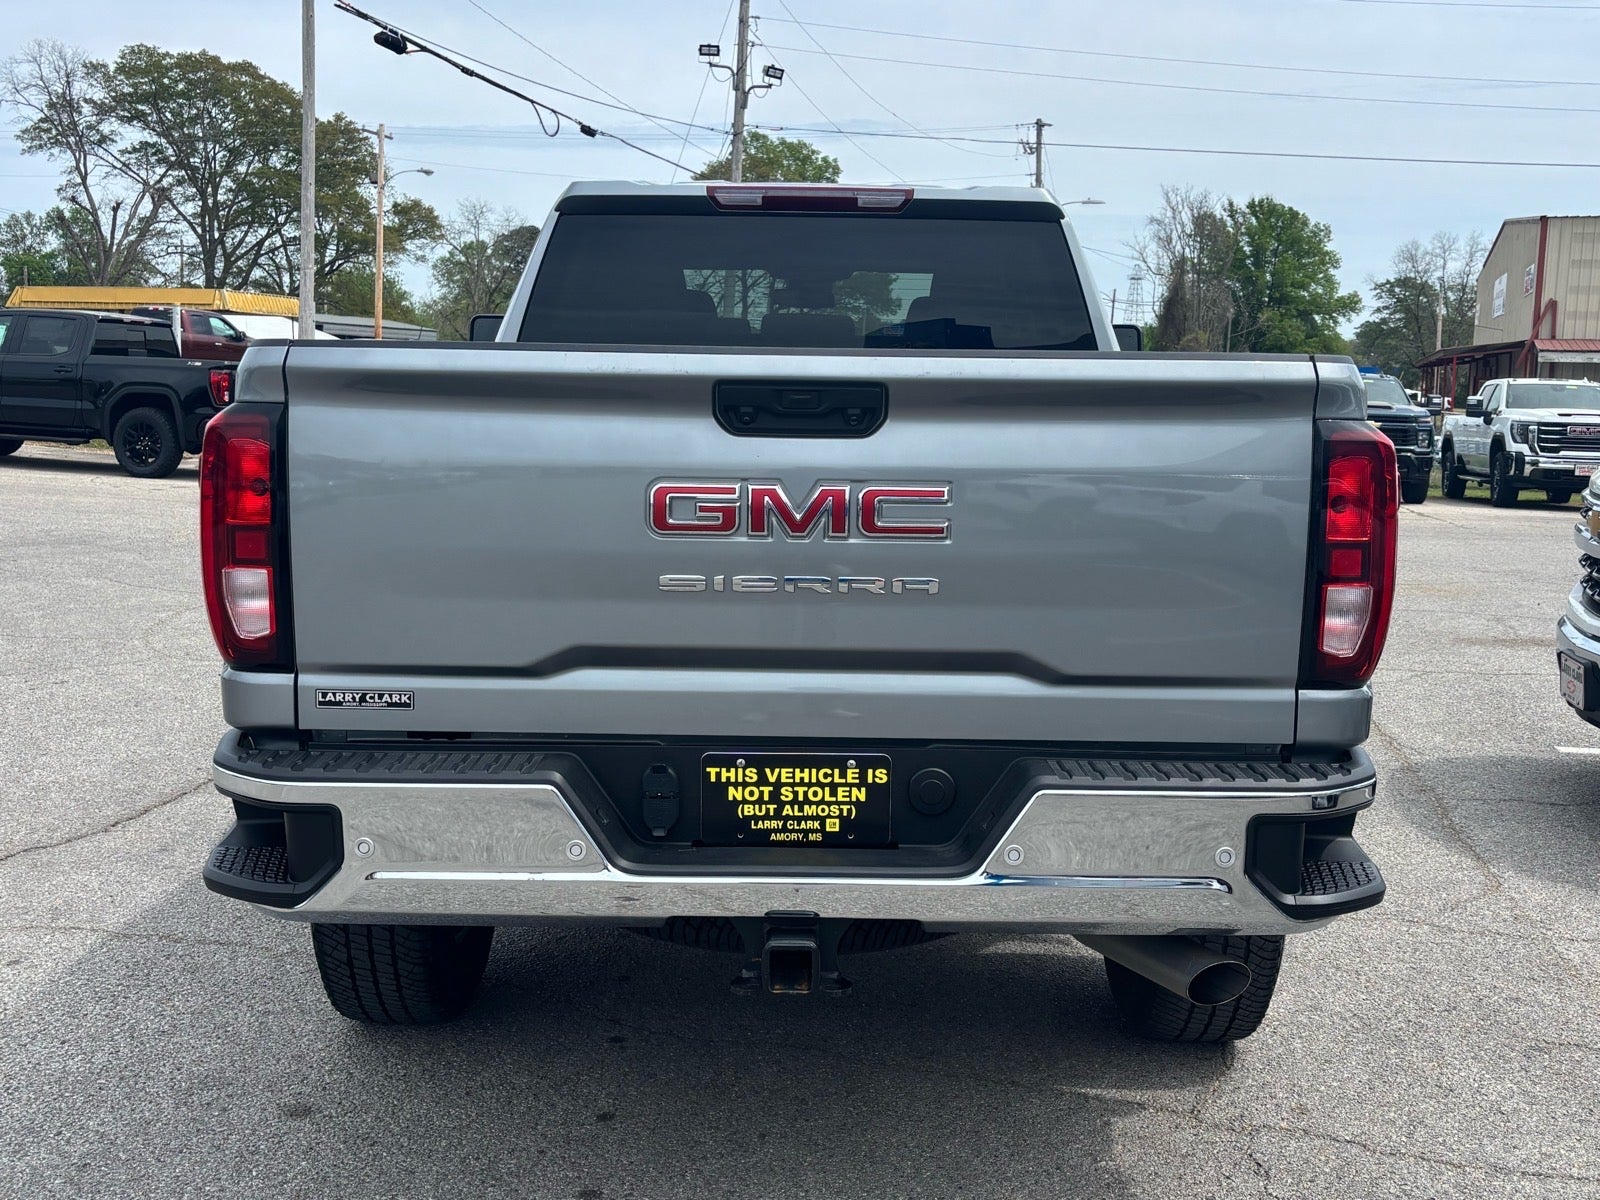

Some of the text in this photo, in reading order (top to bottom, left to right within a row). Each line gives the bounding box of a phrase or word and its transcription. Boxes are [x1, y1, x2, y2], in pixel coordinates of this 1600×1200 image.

[648, 482, 952, 540] GMC
[658, 575, 940, 595] SIERRA
[318, 692, 411, 703] LARRY CLARK
[705, 767, 888, 784] THIS VEHICLE IS
[727, 786, 867, 802] NOT STOLEN
[737, 804, 857, 819] (BUT ALMOST)
[751, 820, 821, 830] LARRY CLARK
[769, 832, 823, 842] AMORY, MS
